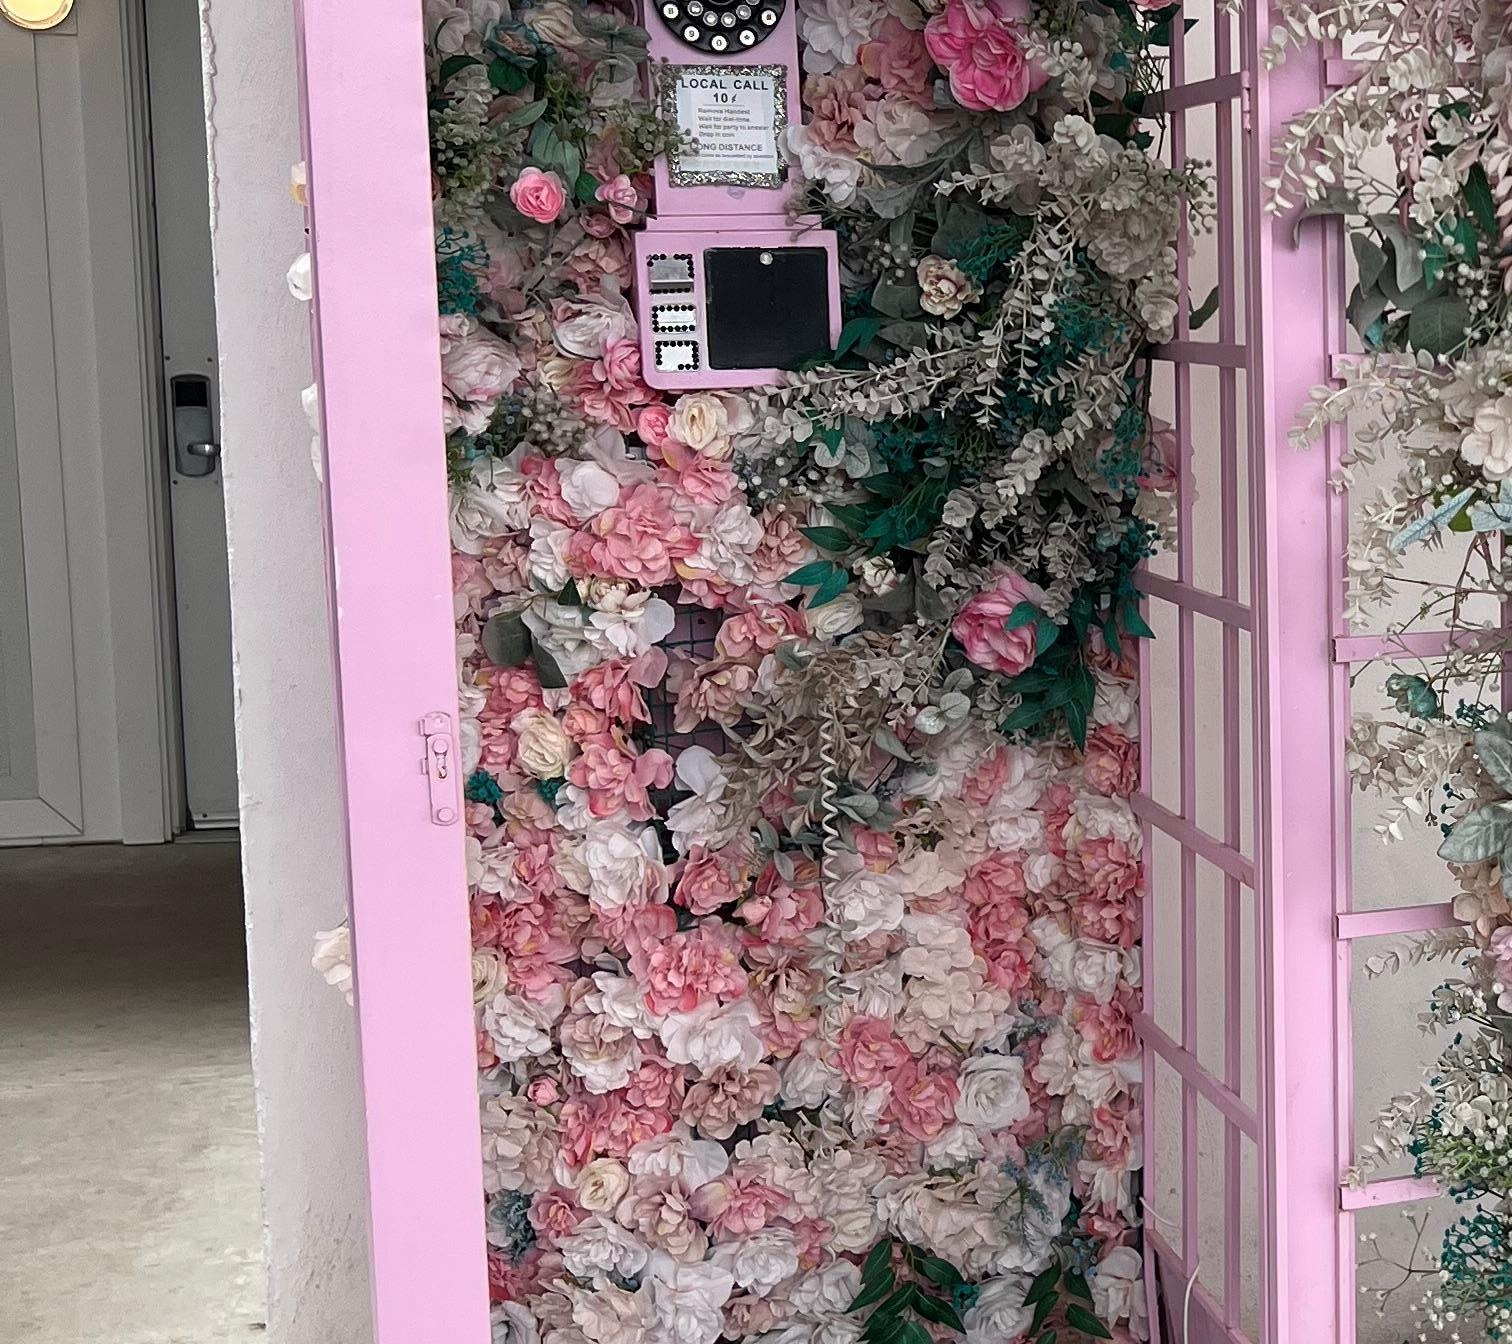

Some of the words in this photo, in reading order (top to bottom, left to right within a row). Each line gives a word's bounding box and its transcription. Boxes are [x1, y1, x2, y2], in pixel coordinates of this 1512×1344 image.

[681, 78, 727, 89] LOCAL
[733, 79, 768, 90] CALL
[690, 143, 716, 151] ONG
[718, 143, 763, 152] DISTANCE
